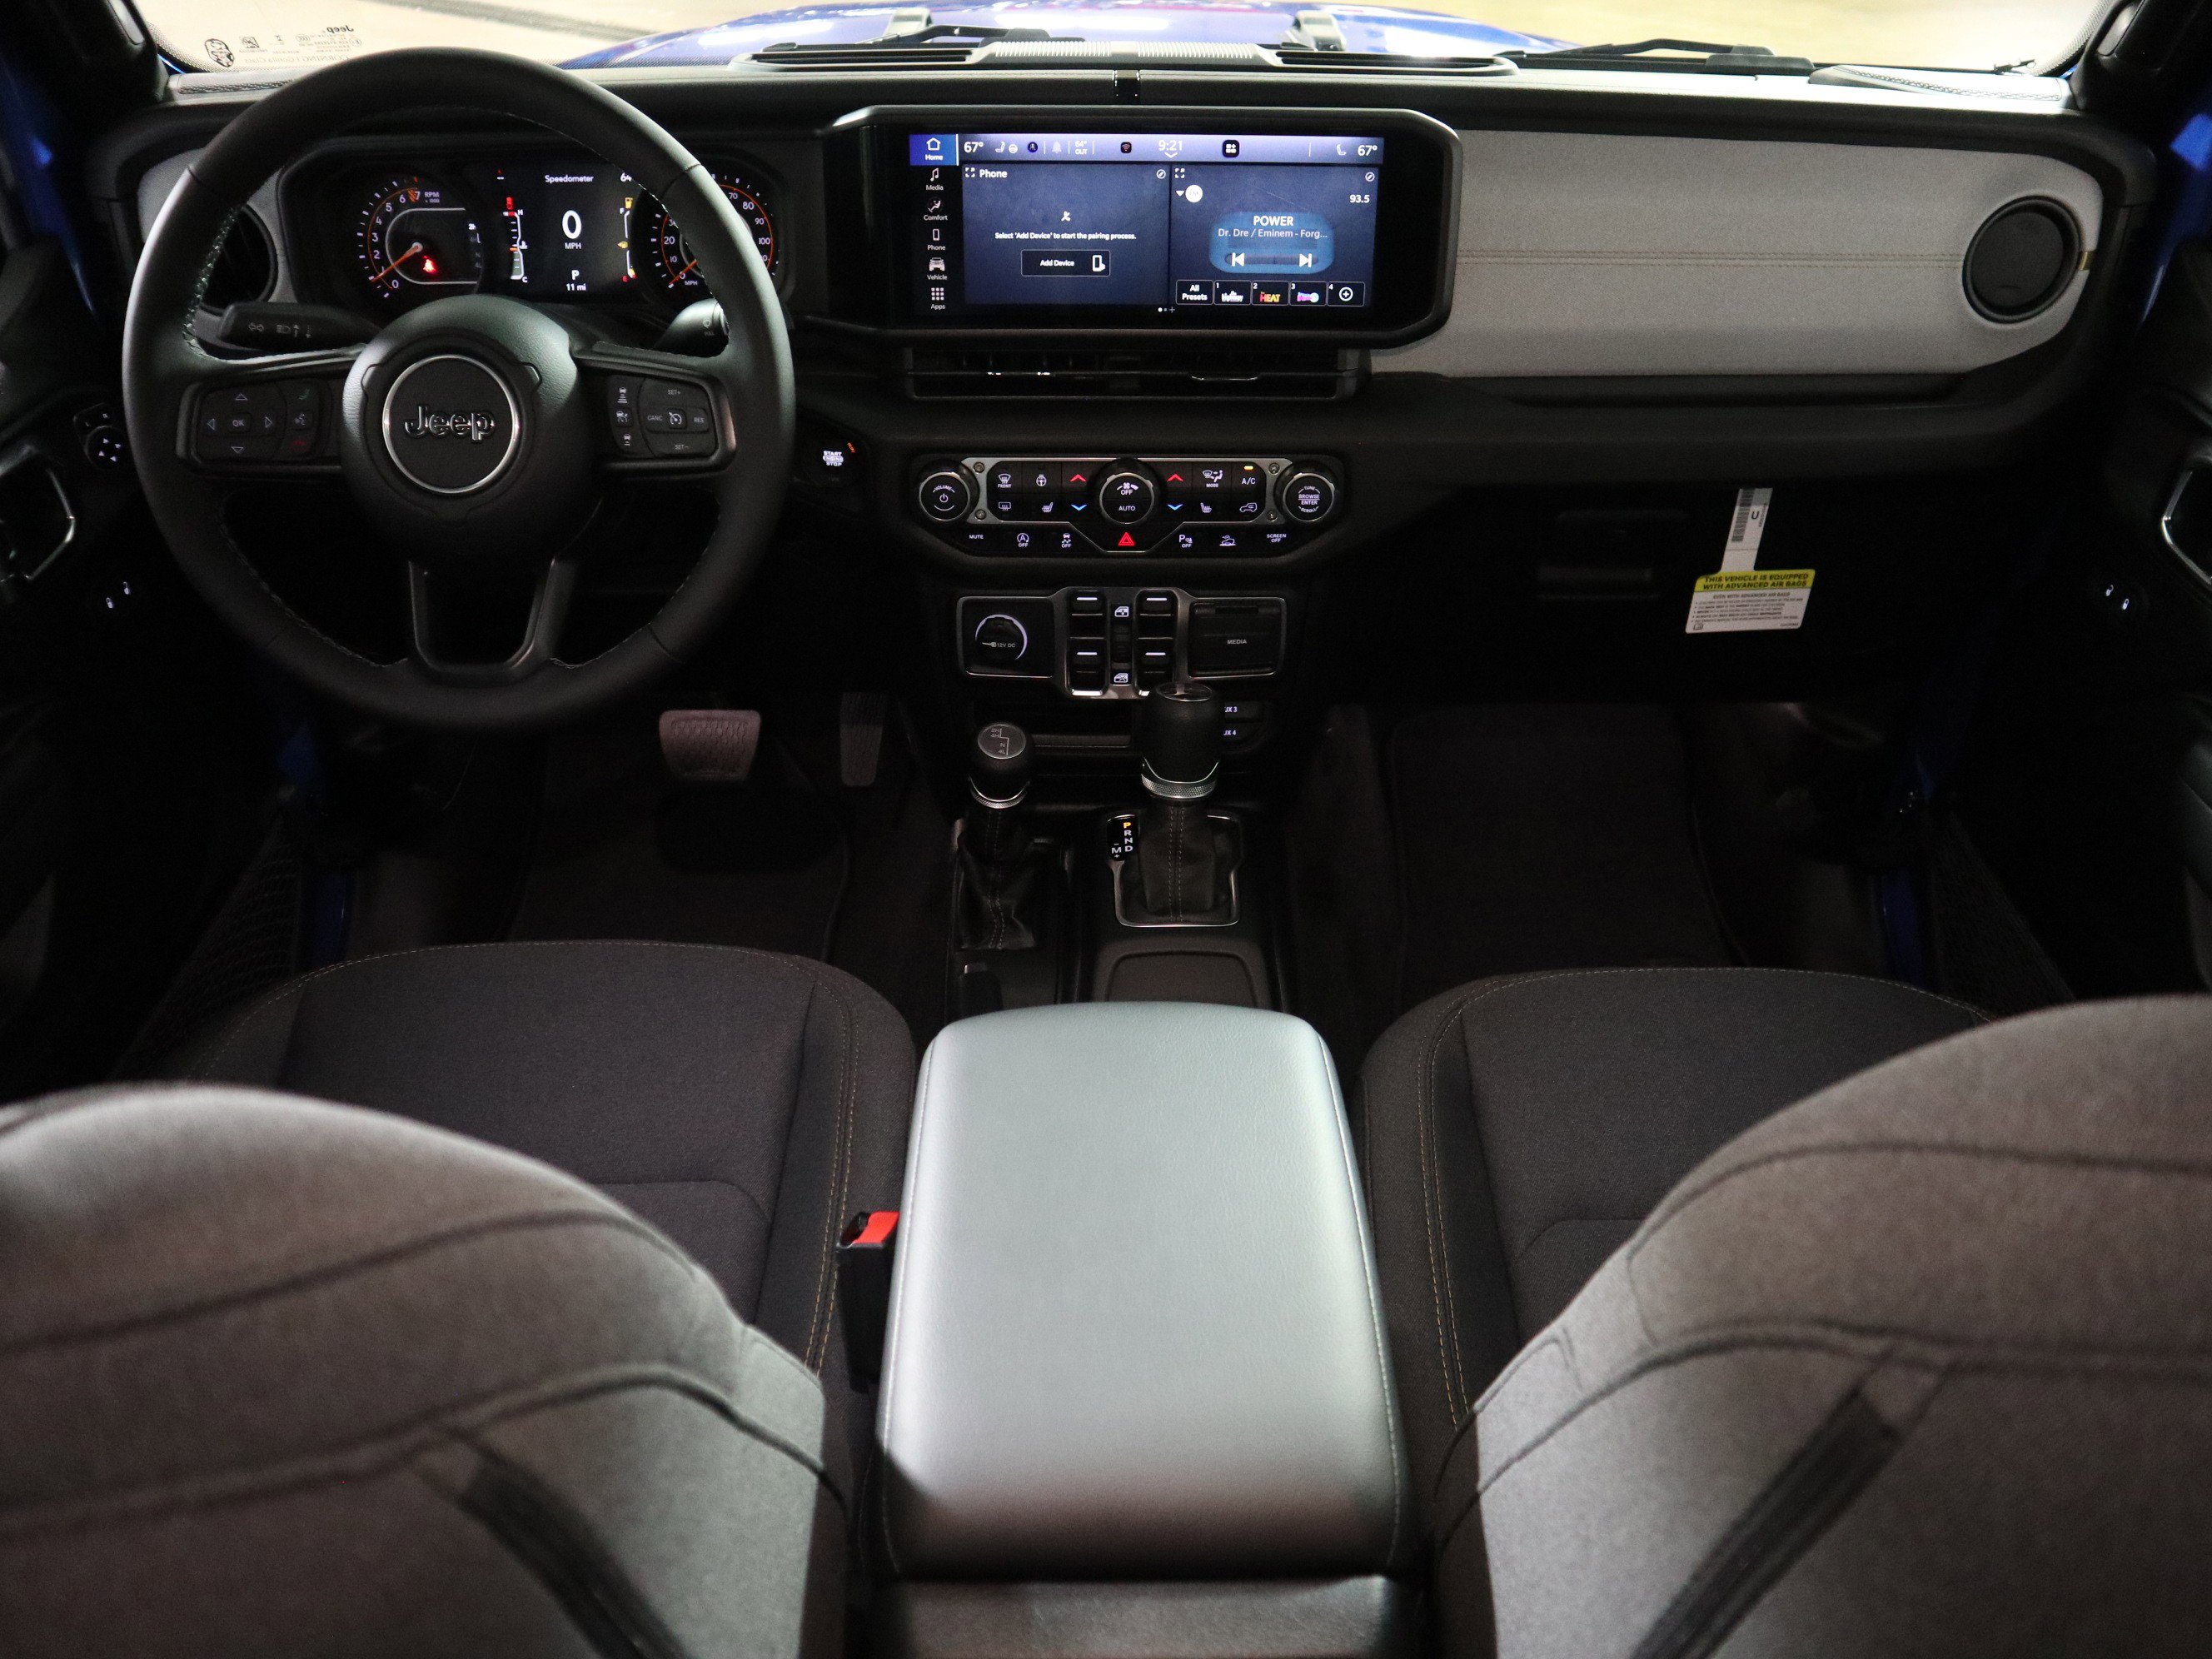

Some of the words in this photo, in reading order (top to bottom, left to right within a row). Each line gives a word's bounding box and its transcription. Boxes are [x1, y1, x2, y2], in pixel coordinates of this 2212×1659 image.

[964, 141, 984, 153] 67°
[1158, 140, 1183, 152] 9:21
[1358, 145, 1378, 157] 67°
[545, 174, 594, 183] Speedometer
[979, 169, 1008, 179] Phone
[399, 194, 406, 203] 6
[415, 191, 421, 200] 7
[1349, 195, 1370, 203] 93.5
[385, 202, 392, 212] 5
[742, 202, 755, 210] 80
[376, 217, 382, 225] 4
[561, 210, 582, 239] 0
[1253, 215, 1293, 226] POWER
[371, 232, 379, 242] 3
[1088, 232, 1109, 241] pairing
[1218, 228, 1231, 237] Dr.
[1233, 228, 1248, 237] Dre
[1258, 228, 1293, 237] Eminem
[664, 236, 675, 245] 20
[373, 250, 381, 260] 2
[571, 270, 580, 280] P
[391, 279, 399, 289] 0
[1182, 292, 1208, 301] Presets
[1259, 292, 1281, 302] HEAT
[404, 405, 496, 441] Jeep
[1241, 476, 1256, 485] A/C
